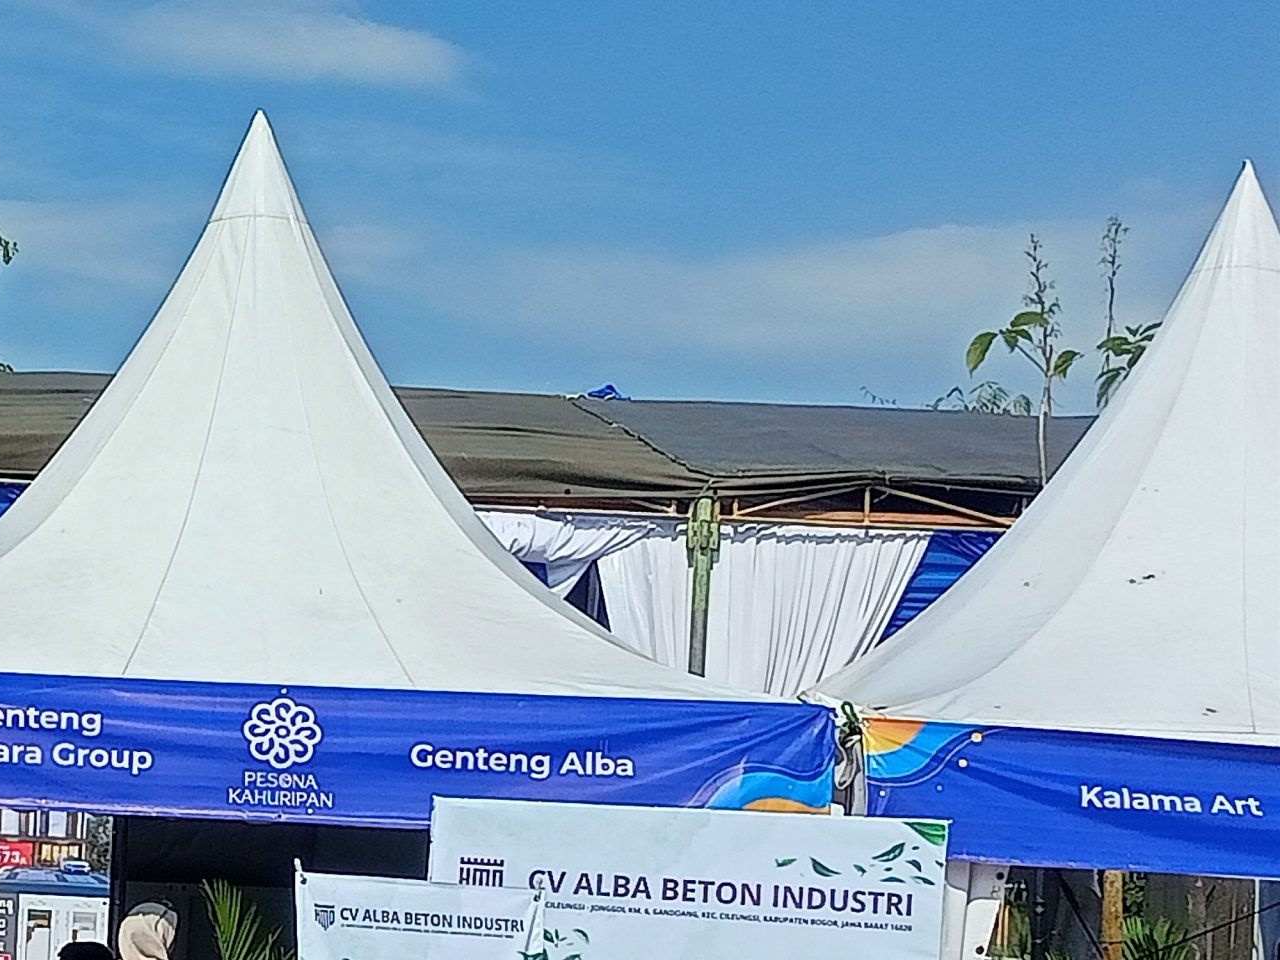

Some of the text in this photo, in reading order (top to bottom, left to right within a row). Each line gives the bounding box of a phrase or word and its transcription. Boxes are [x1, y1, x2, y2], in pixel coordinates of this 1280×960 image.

[51, 742, 153, 775] Group
[410, 744, 635, 778] Genteng Alba
[244, 771, 318, 790] PESONA
[228, 788, 333, 808] KAHURIPAN
[1081, 785, 1263, 816] Kalama Art
[529, 869, 567, 894] CV
[572, 872, 652, 900] ALBA
[661, 878, 762, 906] BETON
[771, 884, 913, 917] INDUSTRI
[340, 907, 360, 921] CV
[362, 909, 401, 925] ALBA
[404, 911, 453, 929] BETON
[456, 915, 525, 933] INDUSTRI
